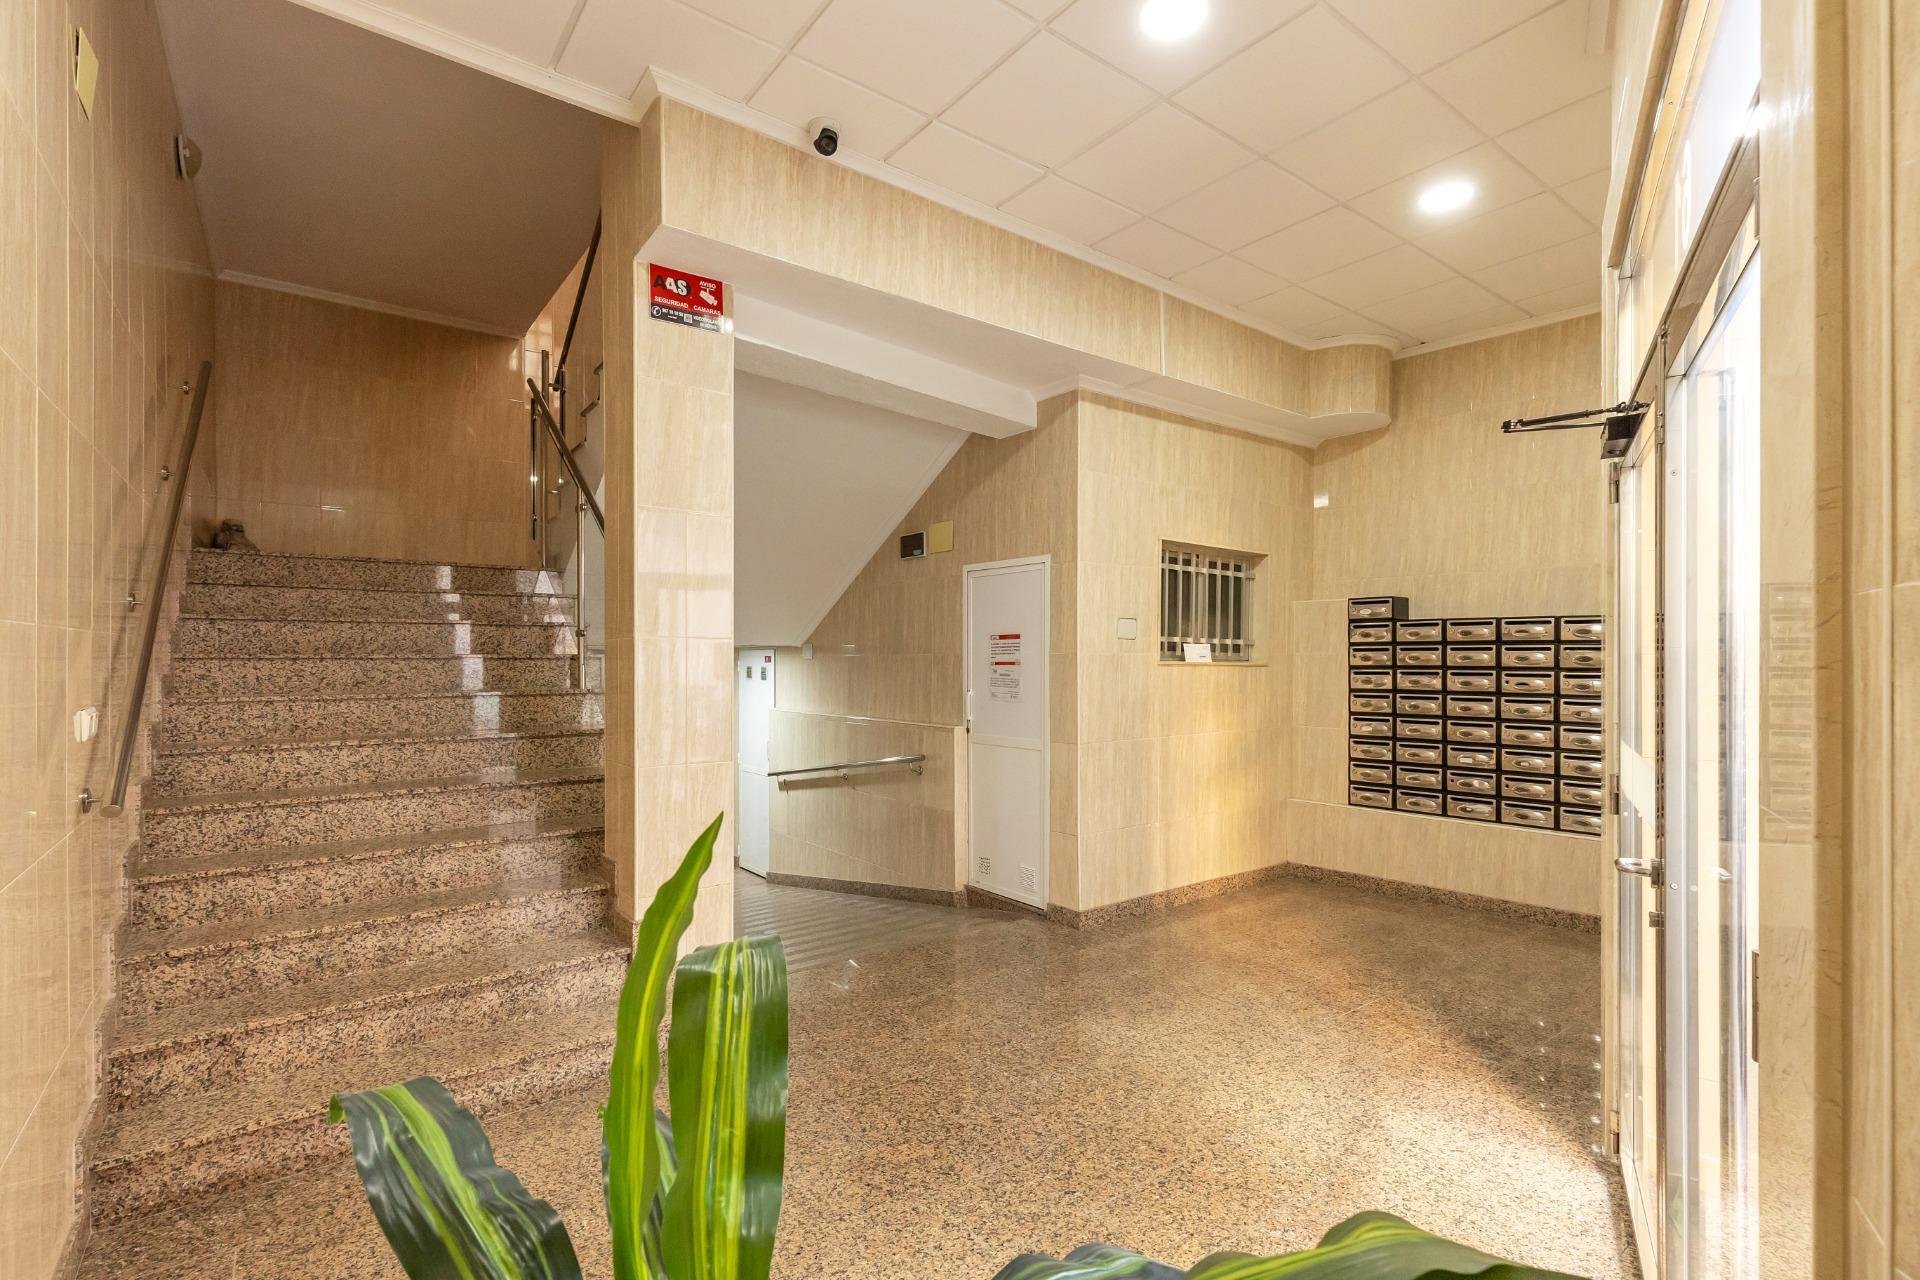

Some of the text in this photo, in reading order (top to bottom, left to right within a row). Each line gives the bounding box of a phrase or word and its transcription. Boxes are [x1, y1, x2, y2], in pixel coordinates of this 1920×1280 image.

[654, 275, 689, 295] AAS
[699, 281, 716, 289] AVISO
[654, 296, 688, 308] SEGURIDAD
[693, 305, 721, 316] CAMARAS
